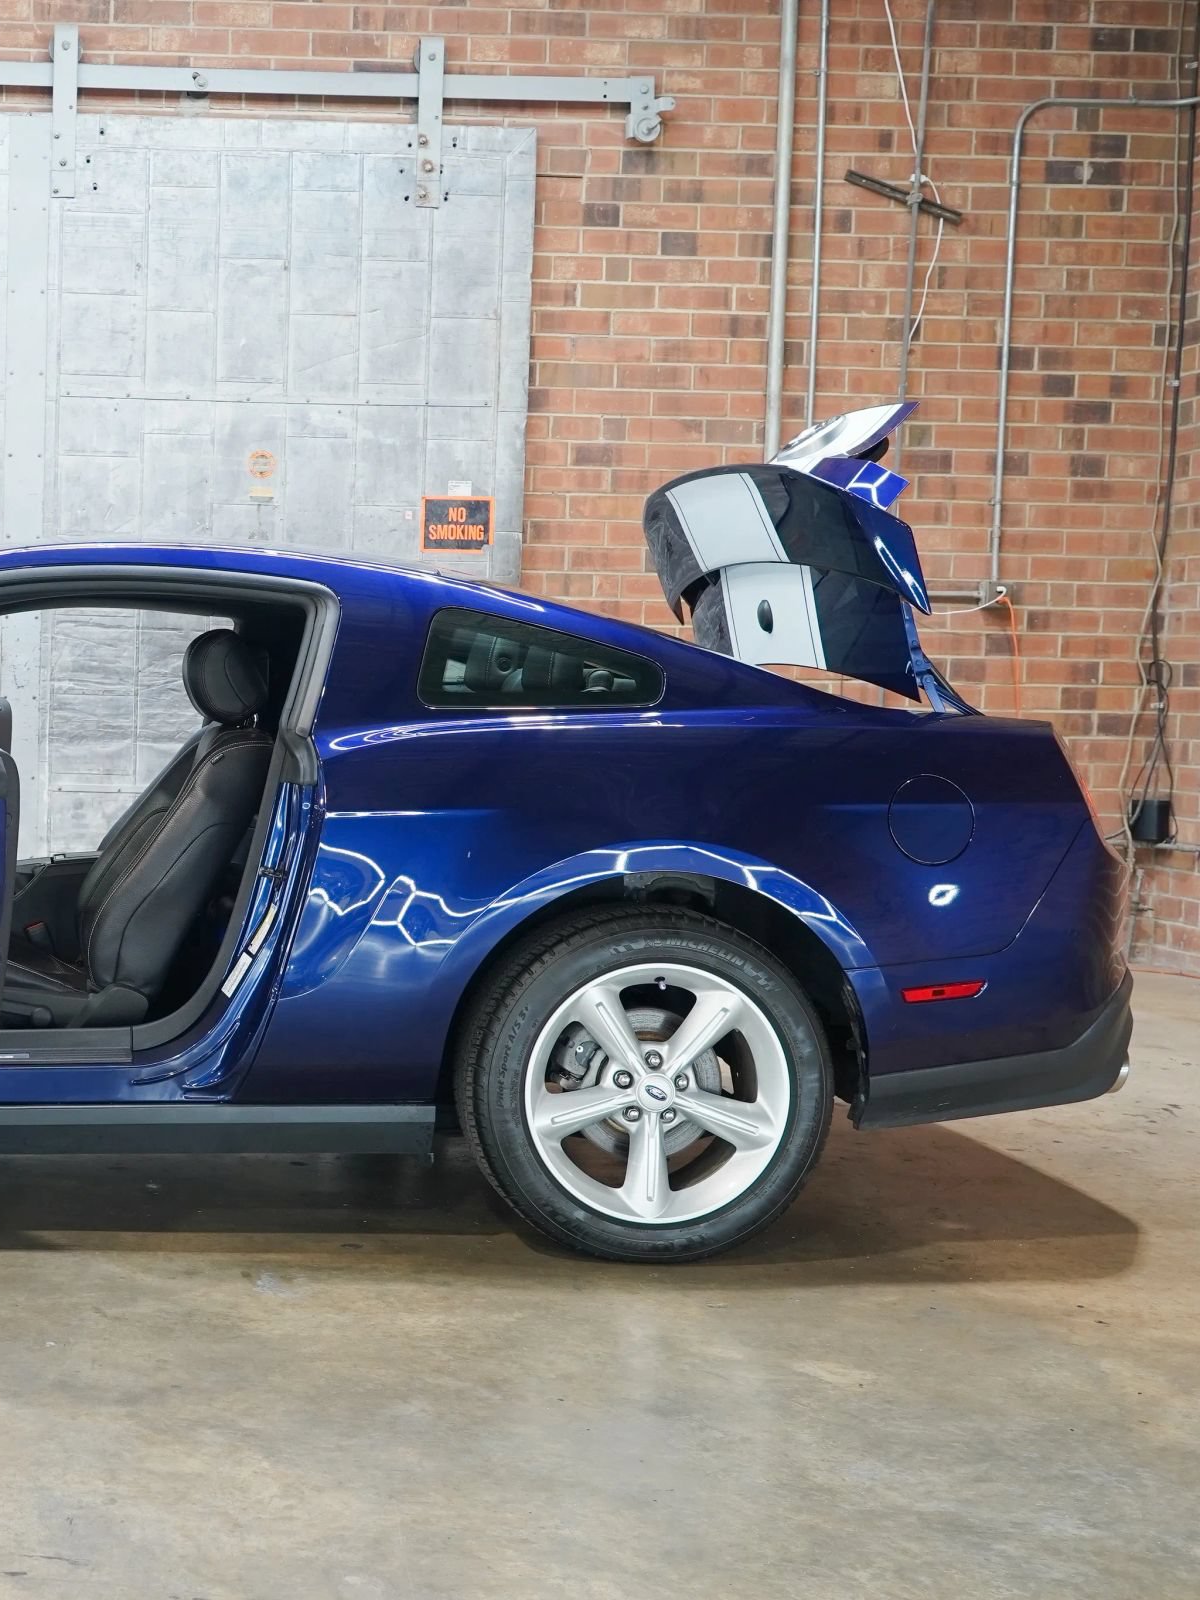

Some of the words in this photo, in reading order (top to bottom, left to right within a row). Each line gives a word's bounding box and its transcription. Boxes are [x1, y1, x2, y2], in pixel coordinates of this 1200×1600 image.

[448, 507, 466, 523] NO
[428, 524, 484, 541] SMOKING
[665, 937, 746, 967] MICHELIN
[508, 1019, 521, 1044] A/S
[498, 1044, 512, 1078] Sport
[495, 1077, 506, 1109] Pilot
